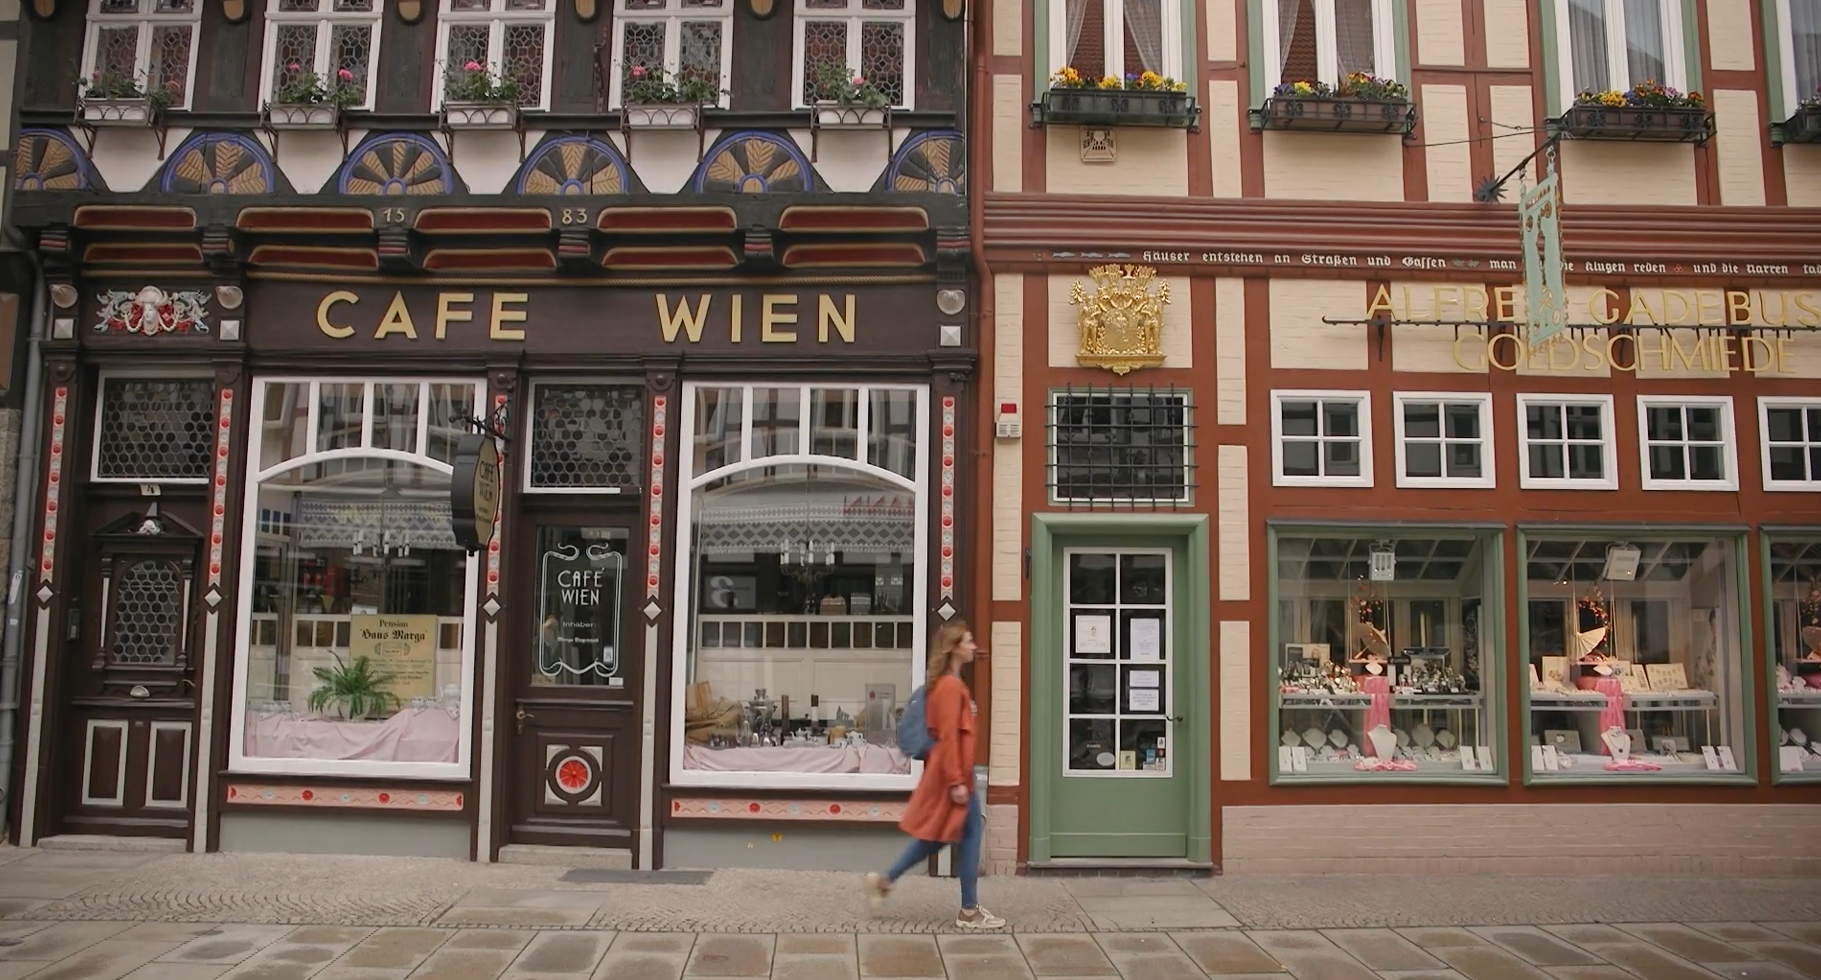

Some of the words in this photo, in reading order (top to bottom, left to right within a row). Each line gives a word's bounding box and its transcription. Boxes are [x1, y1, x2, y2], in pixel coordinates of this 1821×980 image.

[383, 207, 406, 223] 15
[561, 208, 588, 225] 83
[1143, 250, 1190, 263] Häuser
[1202, 251, 1264, 264] entstehen
[1274, 253, 1291, 264] an
[1301, 253, 1358, 267] Straßen
[1367, 255, 1391, 267] und
[1489, 259, 1517, 270] man
[1585, 261, 1626, 274] Klugen
[1633, 262, 1667, 273] reden
[1693, 262, 1717, 274] und
[1722, 263, 1739, 274] die
[1364, 283, 1522, 322] ALFRE
[316, 290, 529, 340] CAFE
[655, 293, 857, 343] WIEN
[561, 589, 600, 606] WIEN
[379, 619, 409, 628] Pension
